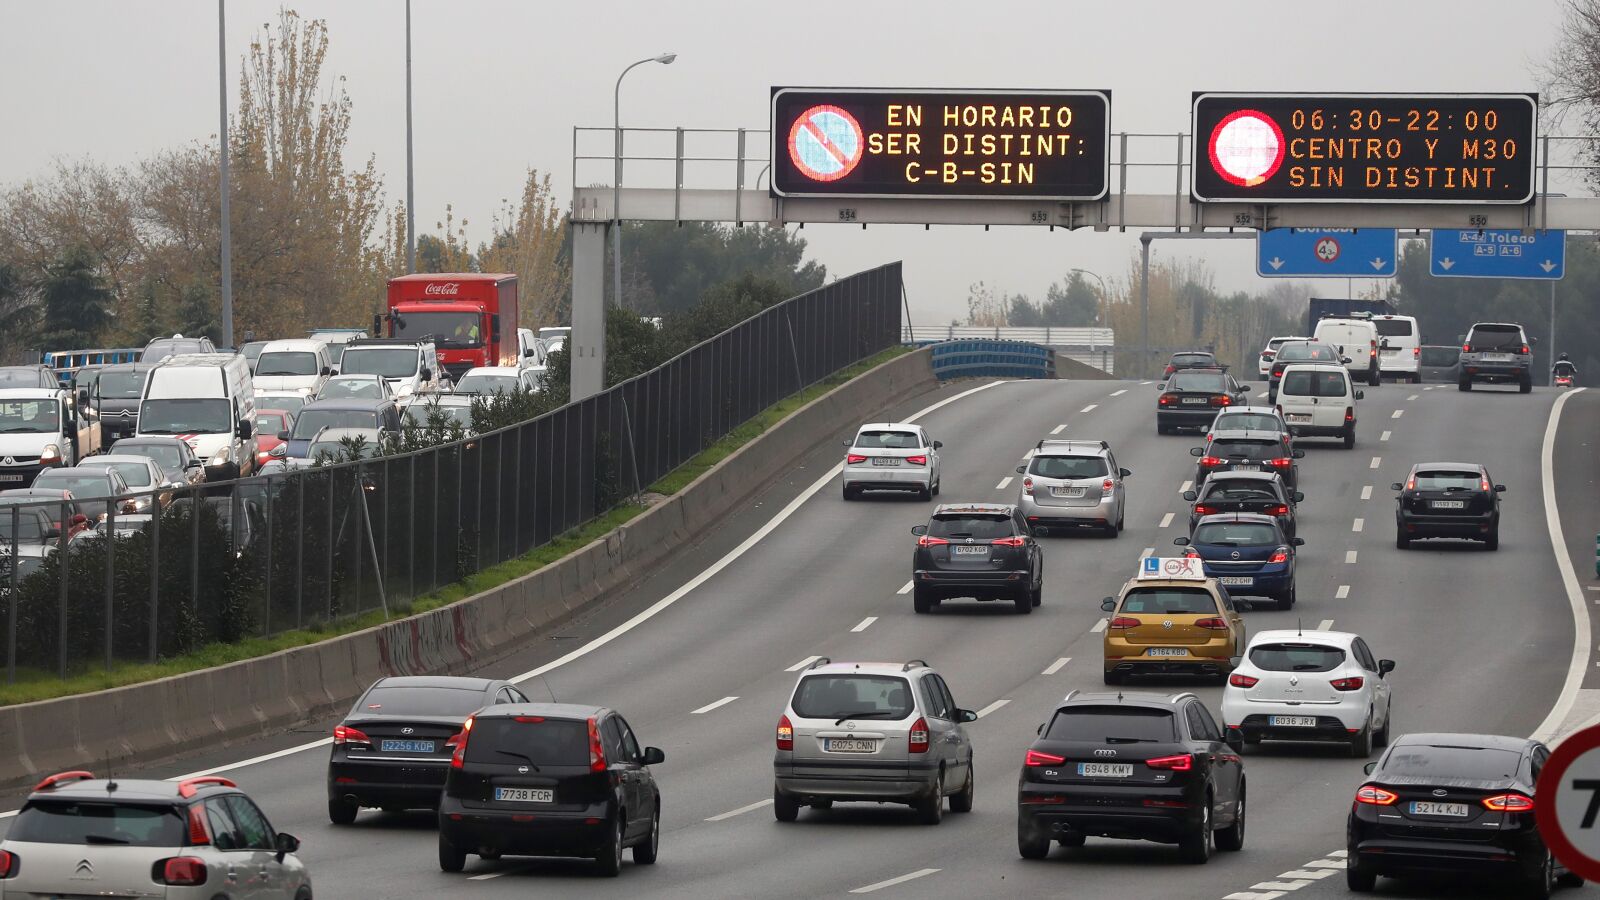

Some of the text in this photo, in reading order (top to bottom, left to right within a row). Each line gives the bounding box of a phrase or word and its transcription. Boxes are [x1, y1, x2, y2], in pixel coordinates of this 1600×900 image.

[888, 105, 1071, 127] EN HORARIO
[869, 133, 920, 154] SER
[1291, 138, 1515, 159] CENTRO Y M30
[906, 162, 1033, 183] C-B-SIN
[1290, 167, 1342, 186] SIN
[1489, 233, 1536, 244] Toledo
[1476, 246, 1520, 256] A-5 A-6
[1147, 559, 1156, 570] L
[1152, 648, 1170, 656] 5164
[1275, 717, 1315, 726] 6036 JRX
[388, 741, 412, 750] 2256
[831, 740, 874, 750] 6075 CNN
[1085, 764, 1131, 775] 6948 KMY
[502, 789, 550, 801] 7738 FCR
[1416, 803, 1466, 815] 5214 KJL
